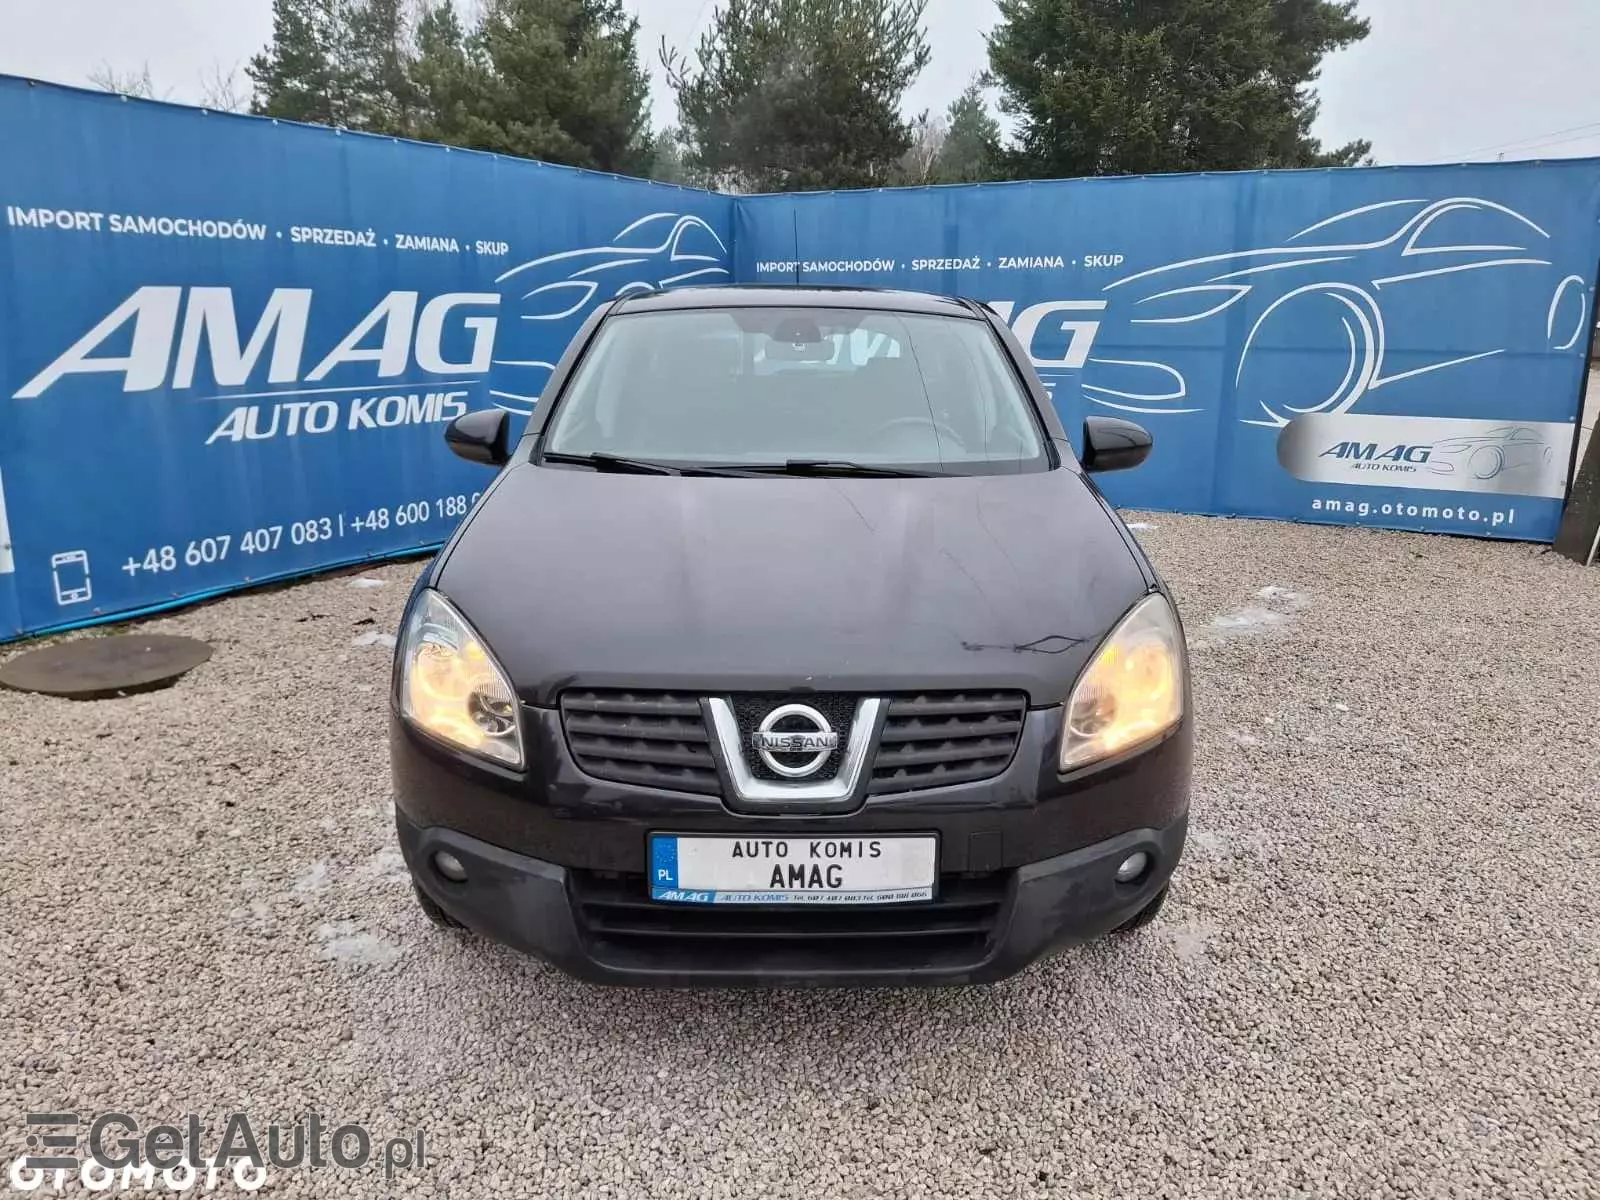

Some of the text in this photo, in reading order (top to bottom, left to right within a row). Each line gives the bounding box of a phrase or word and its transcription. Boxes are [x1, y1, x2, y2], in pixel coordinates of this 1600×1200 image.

[7, 206, 509, 256] IMPORT SAMOCHODÓW SPRZEDAŻ ZAMIANA SKUP
[756, 254, 1124, 273] IMPORT SAMOCHODÓW SPRZEDAŻ ZAMIANA SKUP
[205, 391, 468, 445] AUTO KOMIS
[1318, 441, 1434, 463] AMAG
[1352, 462, 1380, 470] AUTO
[1311, 498, 1515, 525] amag.otomoto.pl
[121, 545, 177, 577] +48
[185, 535, 231, 566] 607
[240, 526, 283, 554] 407
[291, 517, 332, 545] 083
[351, 508, 389, 533] +48
[395, 501, 430, 526] 600
[435, 495, 467, 518] 188
[761, 736, 829, 748] NISSAN
[732, 841, 882, 858] AUTO KOMIS
[658, 869, 673, 881] PL
[769, 863, 843, 889] AMAG
[659, 890, 709, 902] AMAG
